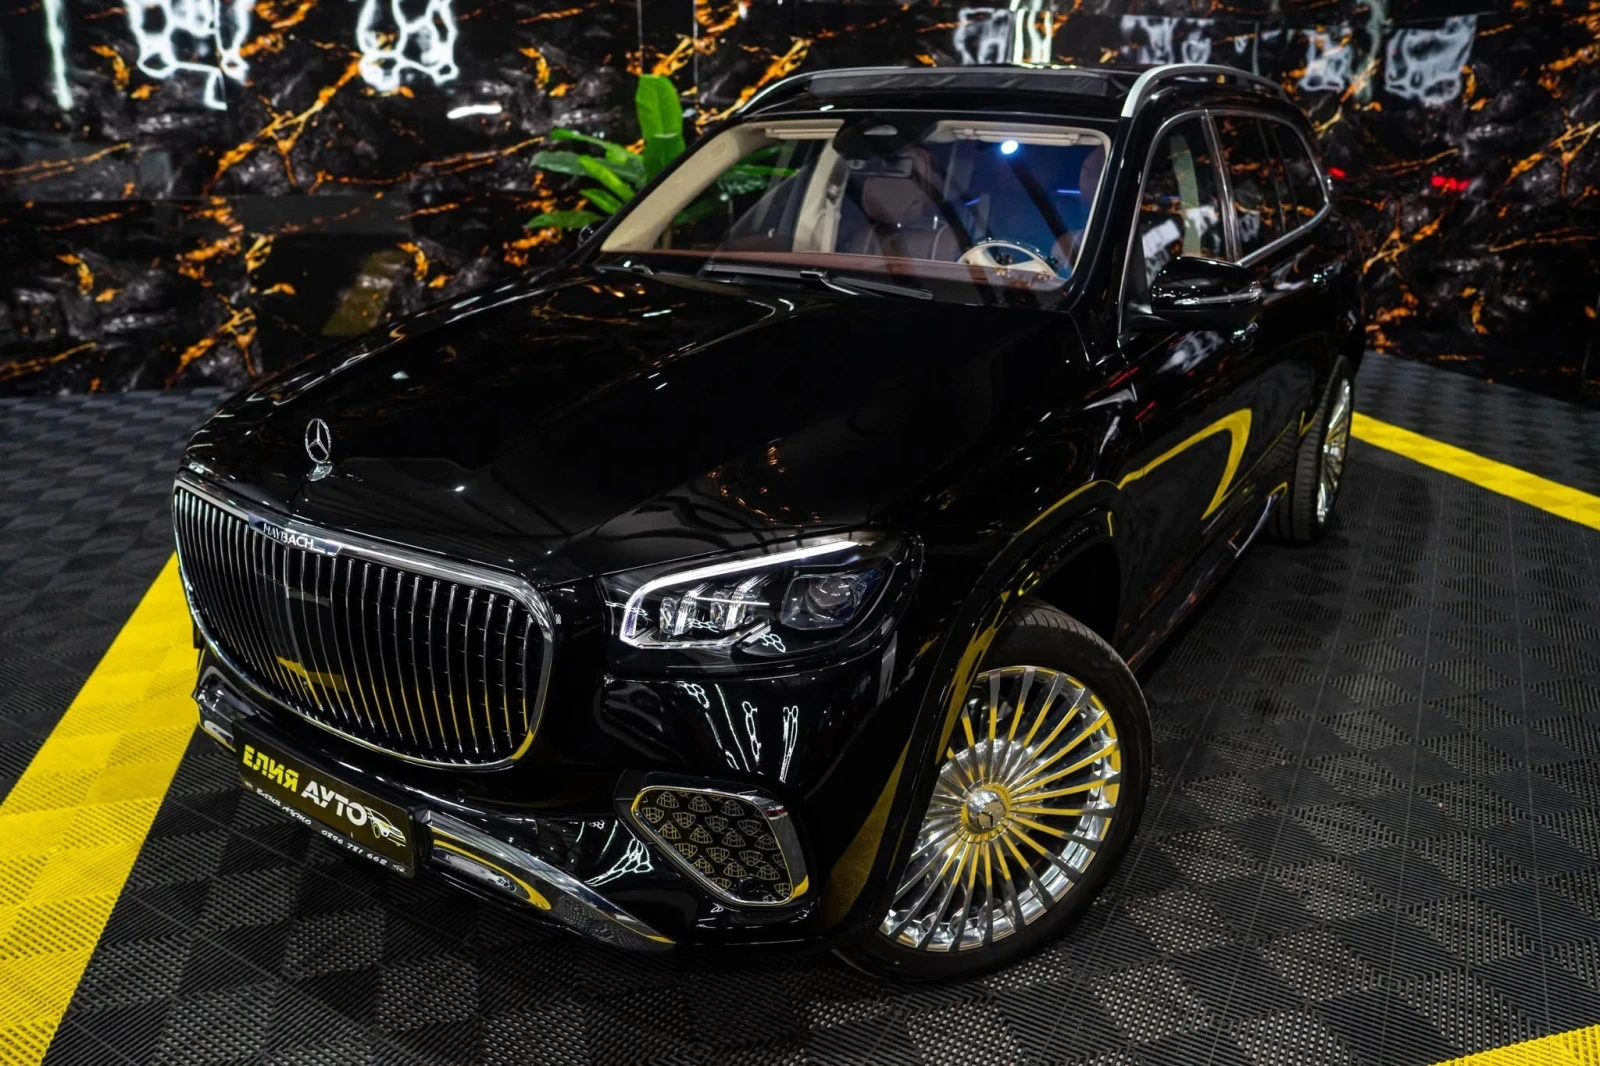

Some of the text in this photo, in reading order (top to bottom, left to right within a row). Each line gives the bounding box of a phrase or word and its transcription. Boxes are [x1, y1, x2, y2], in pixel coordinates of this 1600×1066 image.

[263, 522, 314, 549] MAYBACH
[243, 744, 368, 826] ЕЛИЯ АУТО
